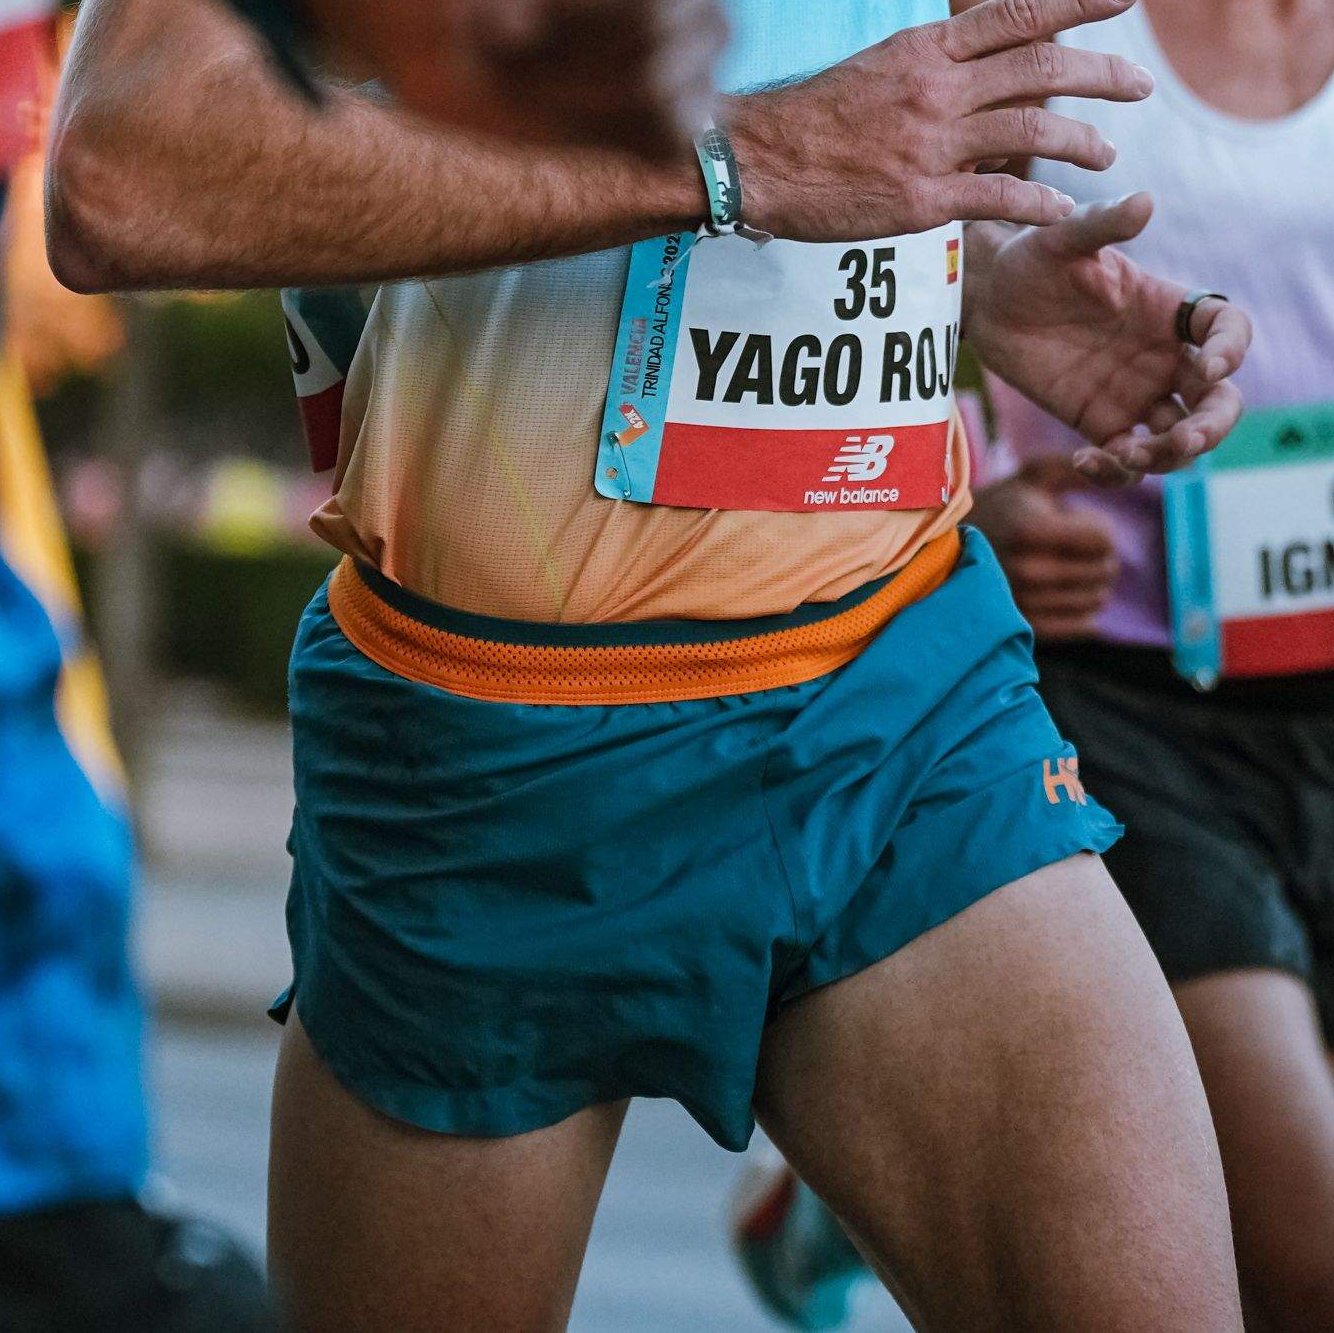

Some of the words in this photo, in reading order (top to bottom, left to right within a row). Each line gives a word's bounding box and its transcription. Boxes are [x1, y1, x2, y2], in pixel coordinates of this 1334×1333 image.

[833, 246, 896, 321] 35
[620, 316, 649, 395] VALENCIA
[641, 335, 666, 400] TRINIDAD
[688, 327, 863, 407] YAGO
[803, 490, 838, 505] new
[839, 486, 900, 505] balance
